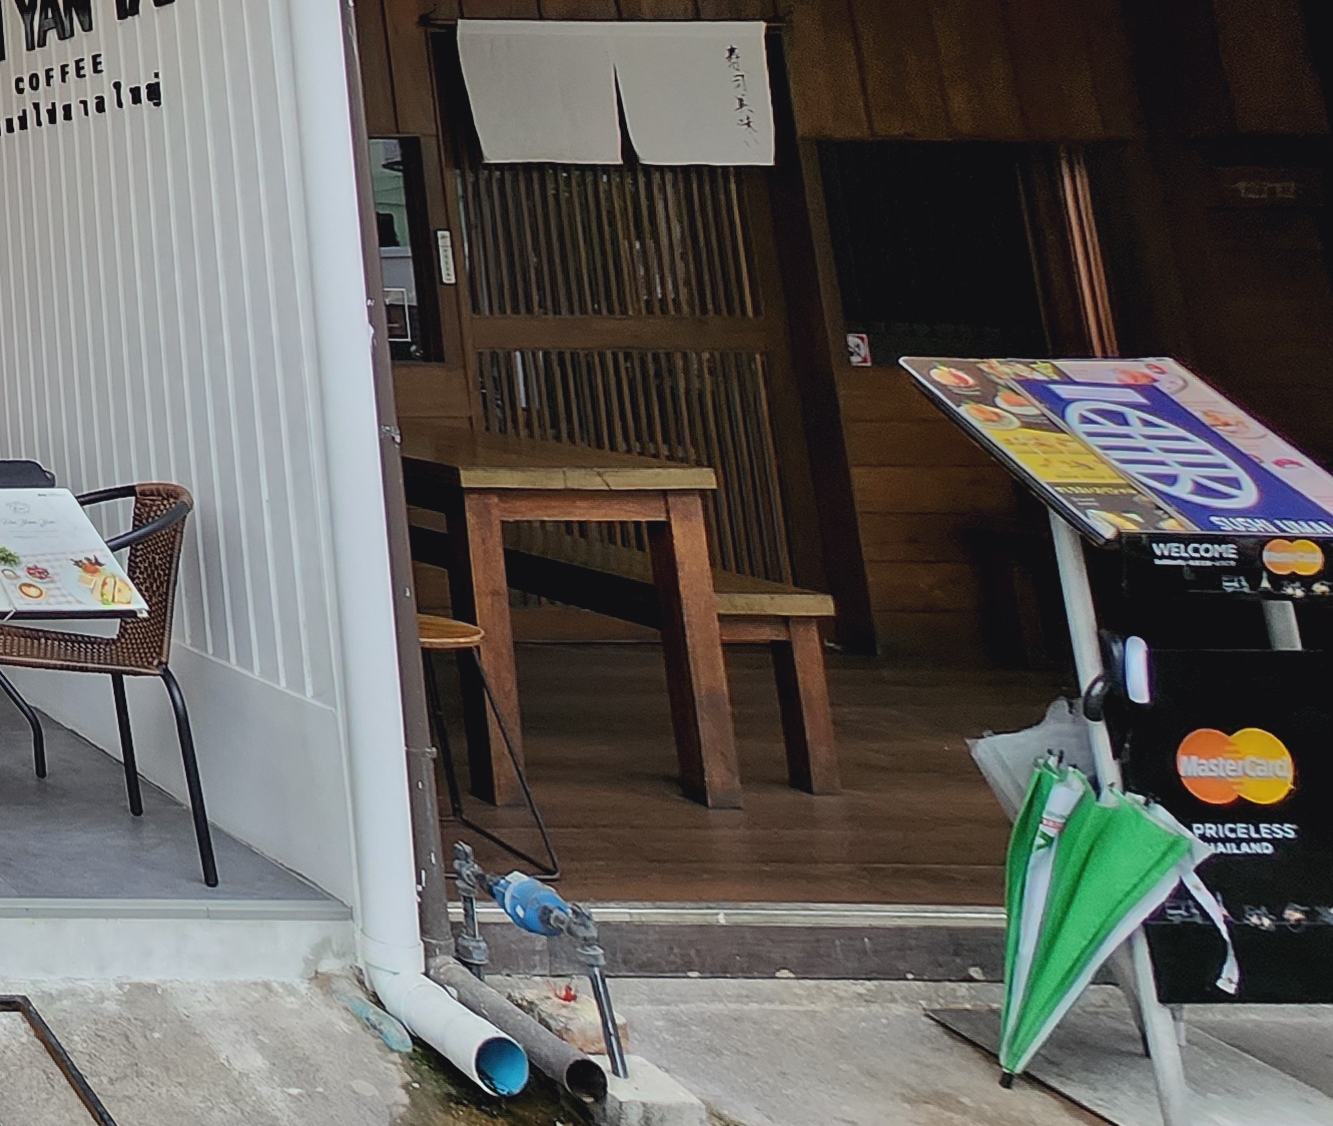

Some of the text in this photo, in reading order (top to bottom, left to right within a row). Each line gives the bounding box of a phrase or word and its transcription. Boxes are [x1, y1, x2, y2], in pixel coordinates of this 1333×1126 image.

[14, 53, 104, 95] COFFEE
[1209, 515, 1280, 534] SUSHI
[1152, 542, 1239, 560] WELCOME
[1180, 755, 1292, 780] MasterCard
[1192, 823, 1299, 839] PRICELESS
